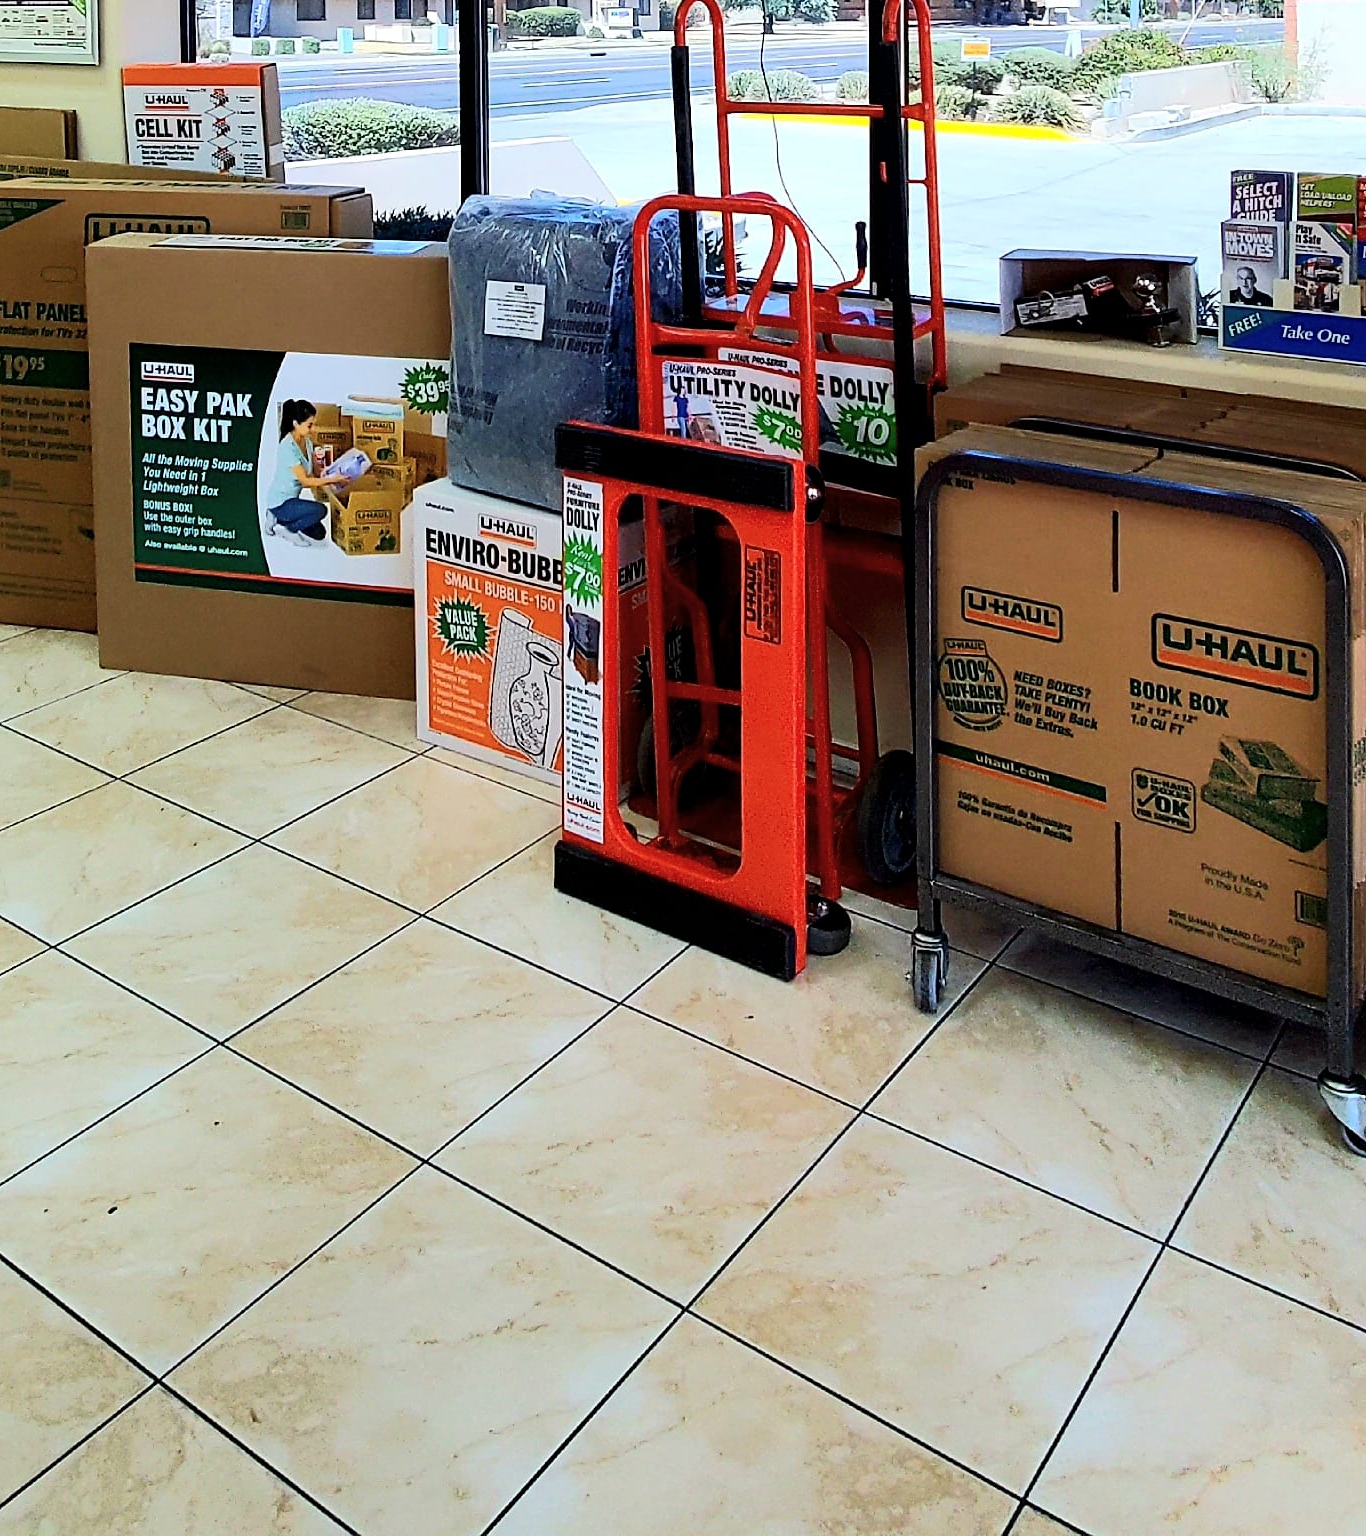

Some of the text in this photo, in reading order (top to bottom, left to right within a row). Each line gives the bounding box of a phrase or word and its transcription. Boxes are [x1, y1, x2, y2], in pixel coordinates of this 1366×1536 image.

[144, 93, 189, 106] U-HAUL
[135, 117, 203, 139] CELL KIT
[1236, 182, 1279, 200] SELECT
[1244, 194, 1282, 211] HITCH
[1225, 232, 1274, 245] IN-TOWN
[1296, 224, 1313, 237] Play
[1302, 234, 1322, 245] Safe
[1225, 243, 1274, 257] MOVES
[37, 302, 87, 323] PANEL
[1228, 312, 1262, 337] FREE!
[1281, 325, 1351, 345] Take One
[143, 363, 193, 378] U-HAUL
[669, 376, 801, 412] UTILITY DOLLY
[829, 376, 890, 404] DOLLY
[140, 387, 253, 418] EASY PAK
[141, 415, 232, 443] BOX KIT
[174, 455, 253, 473] Moving Supplies
[143, 479, 198, 497] Lightweight
[143, 500, 174, 513] BONUS
[480, 516, 534, 540] U-HAUL
[566, 506, 600, 533] DOLLY
[444, 570, 482, 593] SMALL
[444, 608, 478, 626] VALUE
[968, 592, 1057, 627] U-HAUL
[450, 625, 478, 642] PACK
[1162, 623, 1309, 676] U-HAUL
[944, 658, 996, 684] 100%
[1013, 671, 1092, 698] NEED BOXES?
[1014, 684, 1091, 713] TAKE PLENTY!
[1129, 678, 1230, 719] BOOK BOX
[1014, 699, 1098, 730] We'll Buy Back
[1131, 714, 1185, 736] 1.0 CU FT
[975, 753, 1051, 784] uhaul.com
[567, 792, 601, 811] U-HAUL
[1154, 793, 1189, 819] OK
